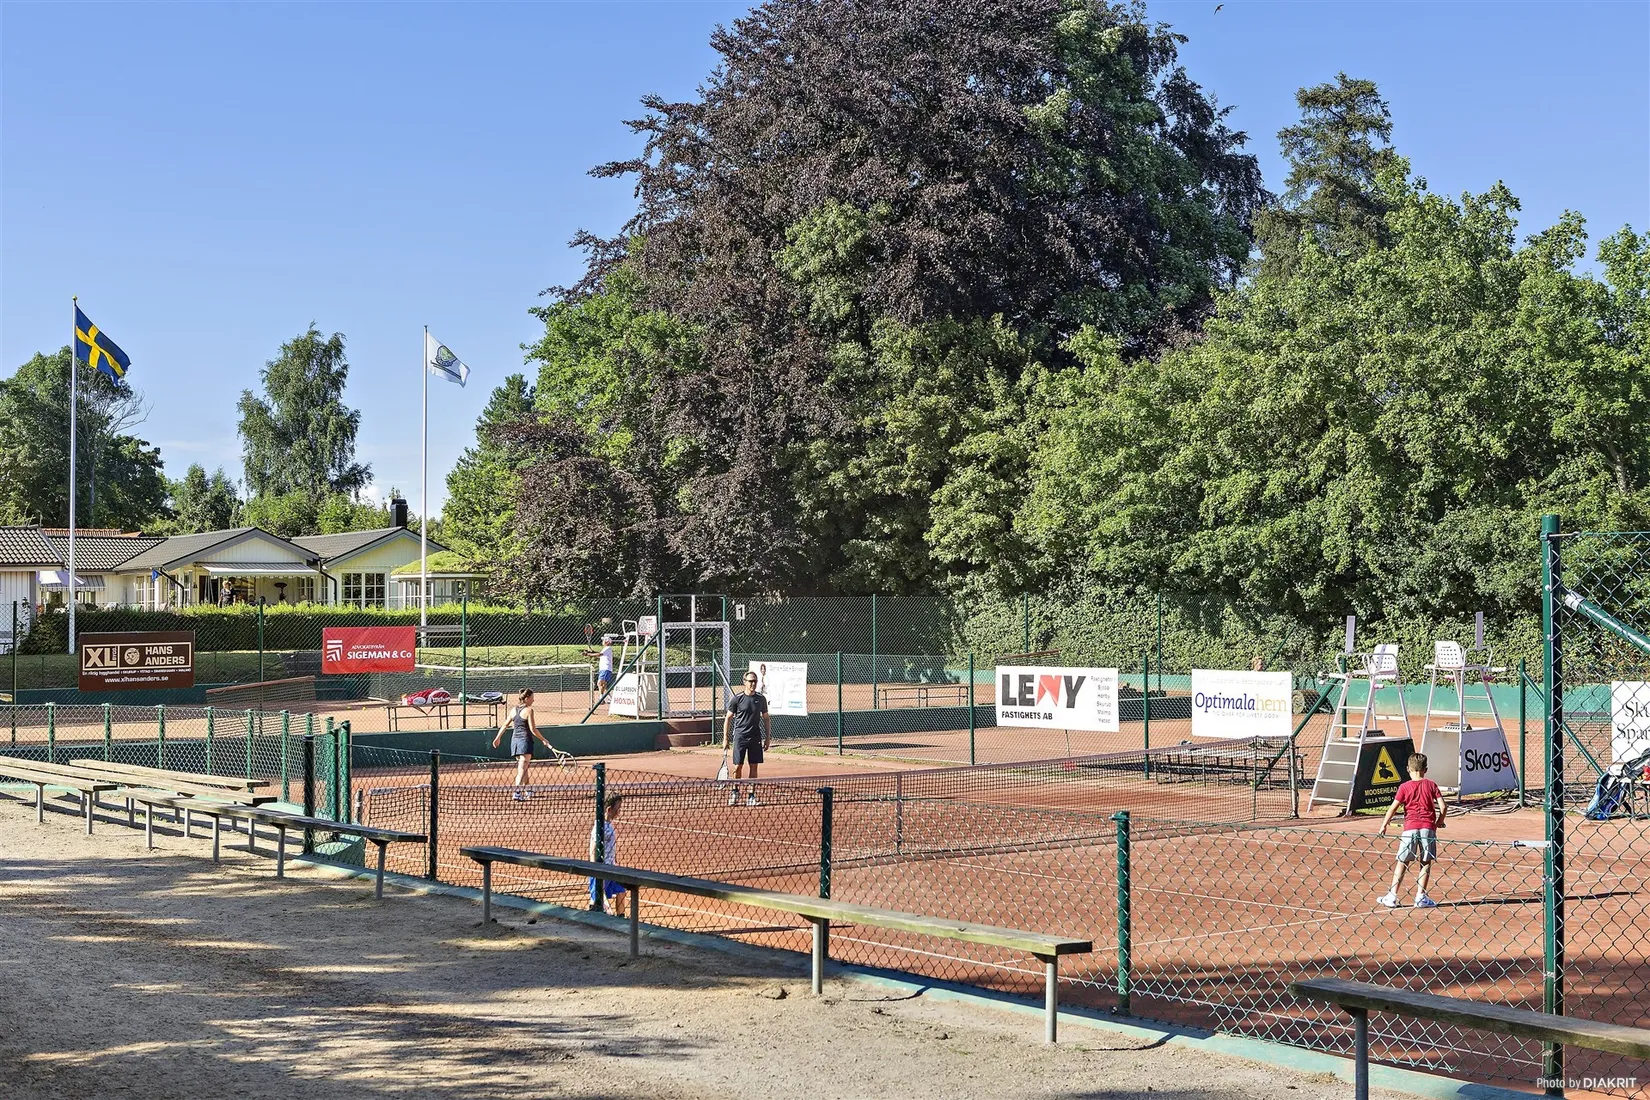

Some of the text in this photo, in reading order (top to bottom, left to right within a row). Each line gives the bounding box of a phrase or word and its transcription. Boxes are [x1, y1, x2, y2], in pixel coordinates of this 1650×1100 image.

[145, 646, 173, 655] HANS
[347, 650, 412, 660] SIGEMAN & Co
[85, 648, 117, 667] XL
[145, 656, 185, 666] ANDERS
[104, 675, 169, 683] www.xlhansanders.se
[1002, 674, 1087, 709] LENY
[613, 697, 636, 706] HONDA
[1195, 692, 1287, 713] Optimalahem
[1001, 711, 1053, 720] FASTIGHETS AB
[1465, 749, 1510, 773] Skogs
[1365, 787, 1398, 796] MOOSEHEAD
